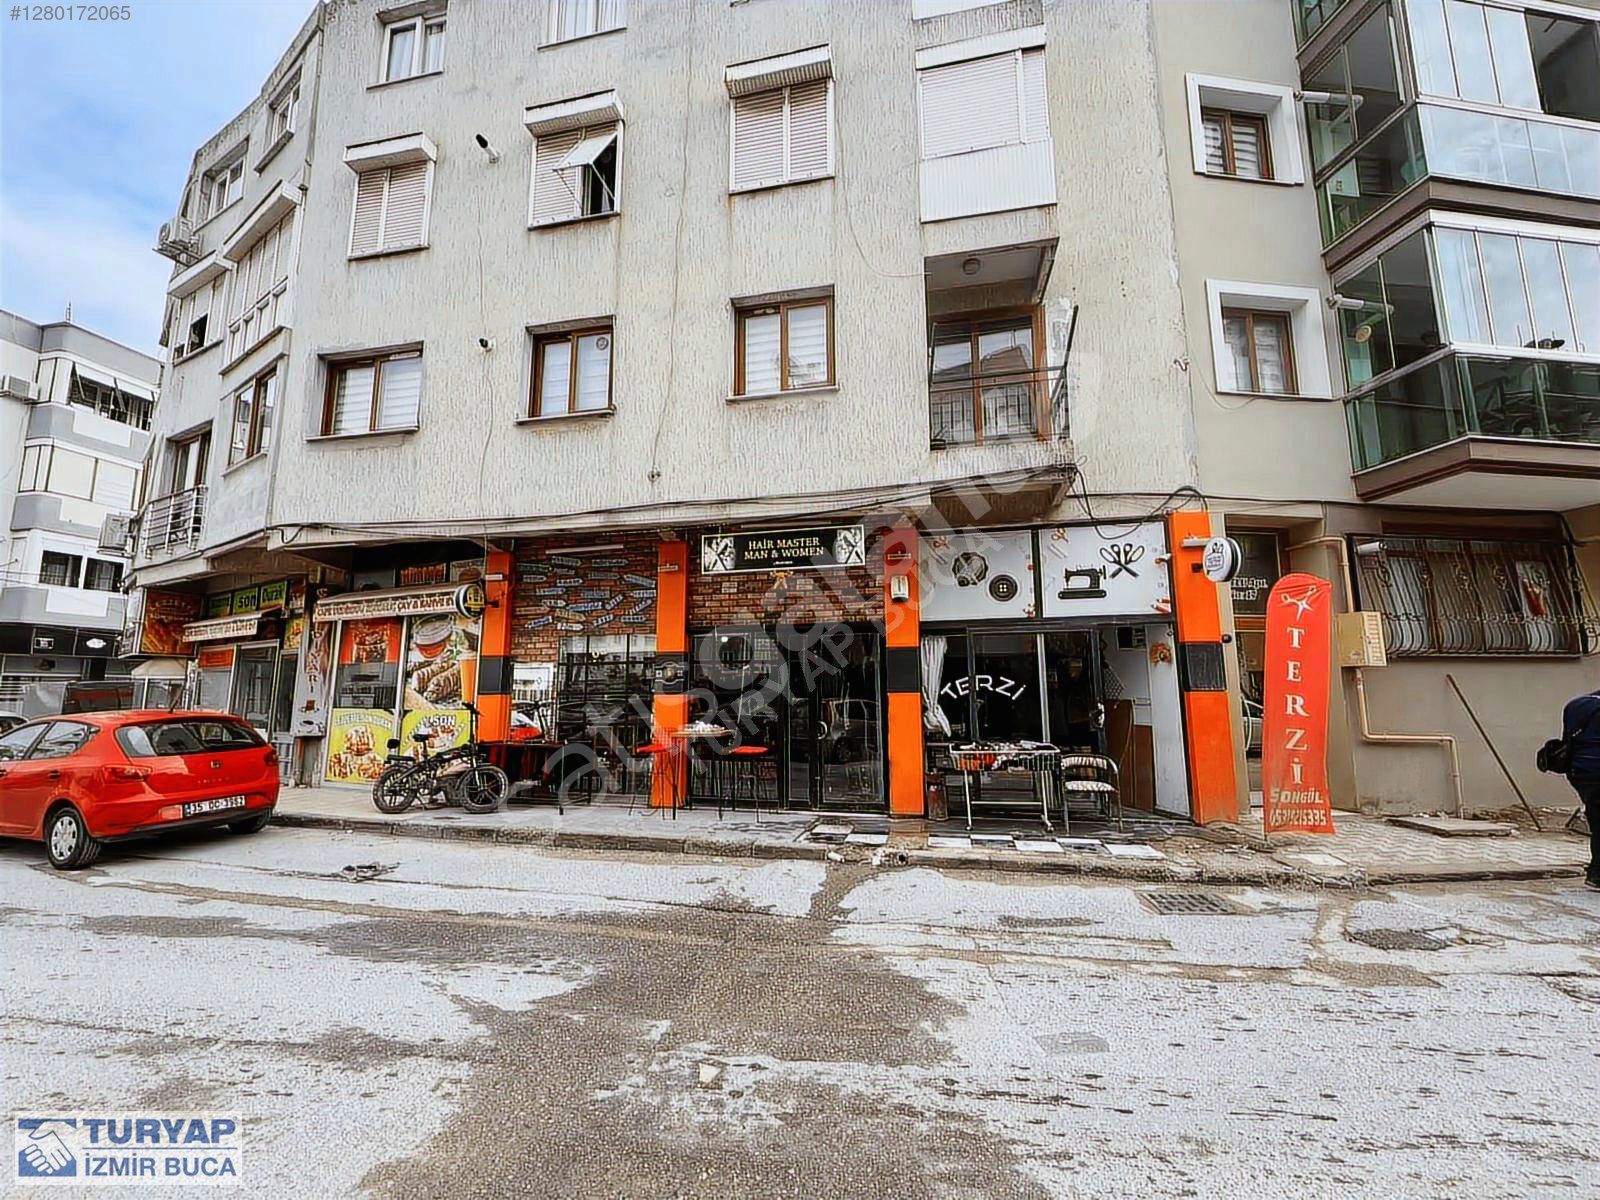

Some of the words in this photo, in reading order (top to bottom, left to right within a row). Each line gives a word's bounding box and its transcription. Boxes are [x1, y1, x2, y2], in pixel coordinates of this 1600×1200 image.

[777, 536, 821, 549] MASTER
[744, 550, 769, 560] MAN
[771, 550, 779, 558] &
[782, 546, 824, 558] WOMEN
[940, 674, 1026, 700] TERZİ
[1284, 627, 1310, 785] TERZİ
